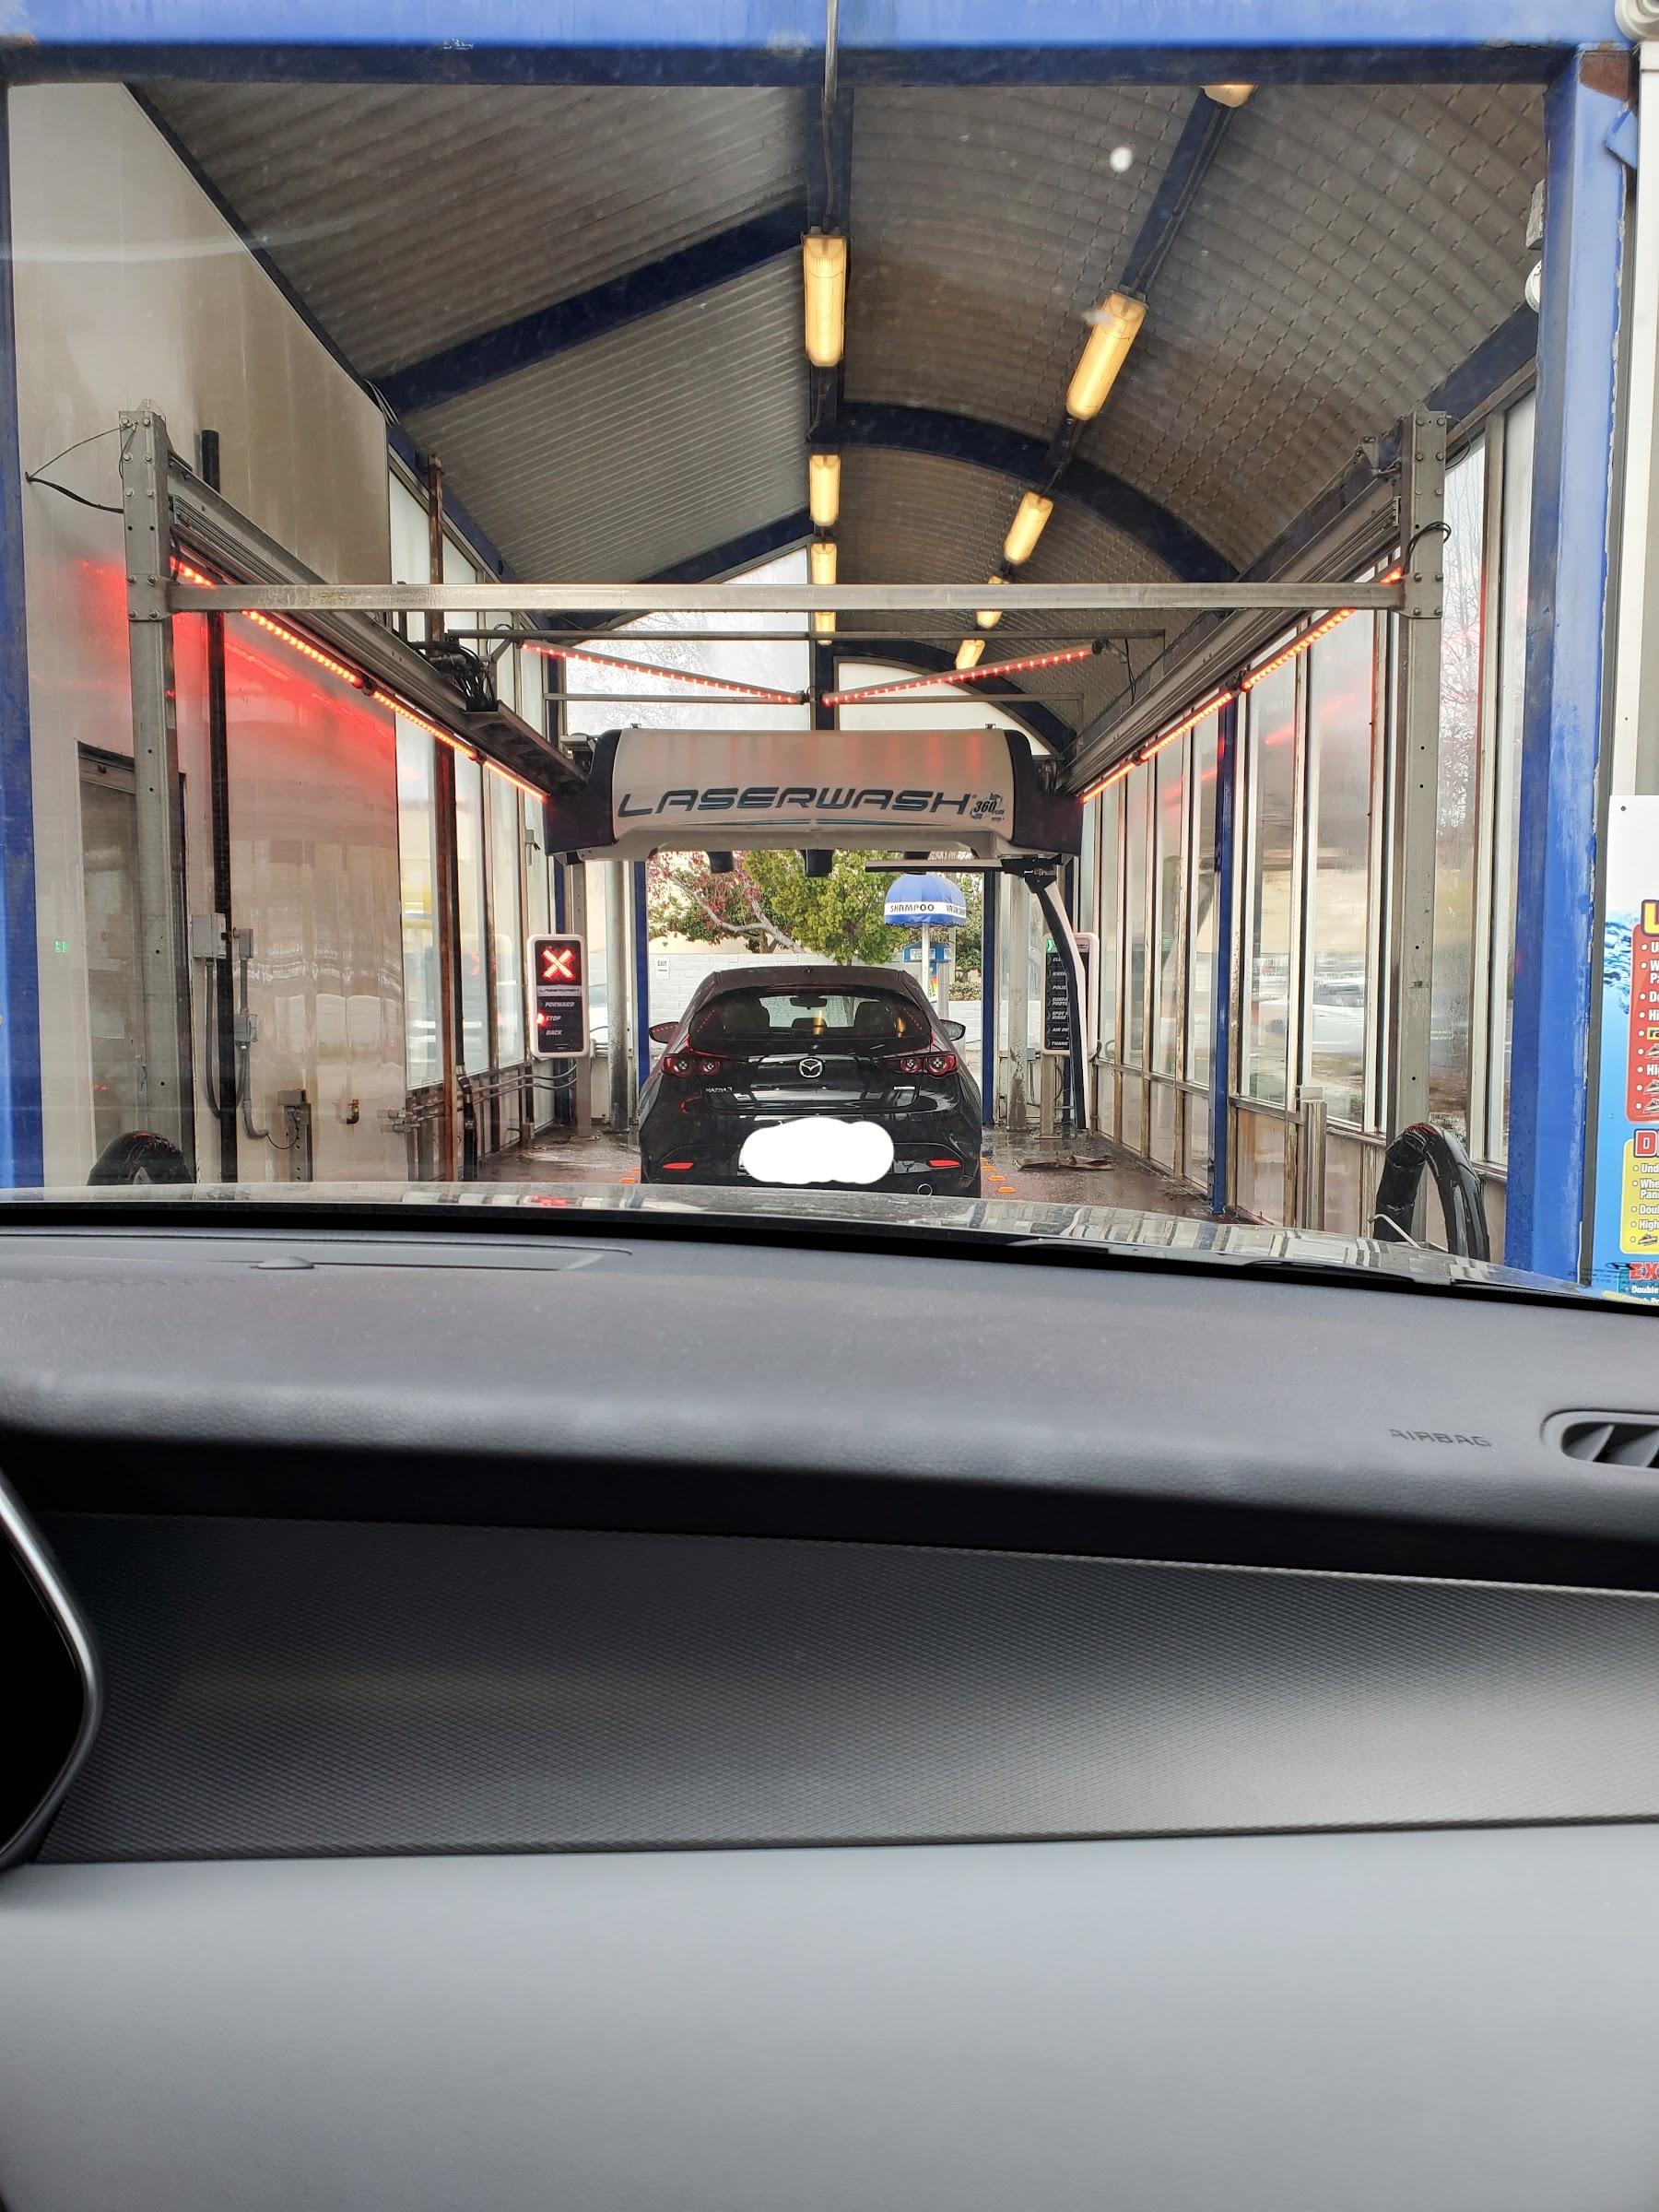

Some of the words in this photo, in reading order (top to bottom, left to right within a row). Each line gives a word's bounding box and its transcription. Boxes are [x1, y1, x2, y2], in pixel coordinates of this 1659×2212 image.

[618, 786, 971, 818] LASERWASH
[973, 800, 997, 813] 360
[890, 904, 935, 912] SHAMPOO
[1651, 941, 1659, 953] U
[1631, 1286, 1659, 1294] Double
[1389, 1429, 1492, 1448] AIRBAG
